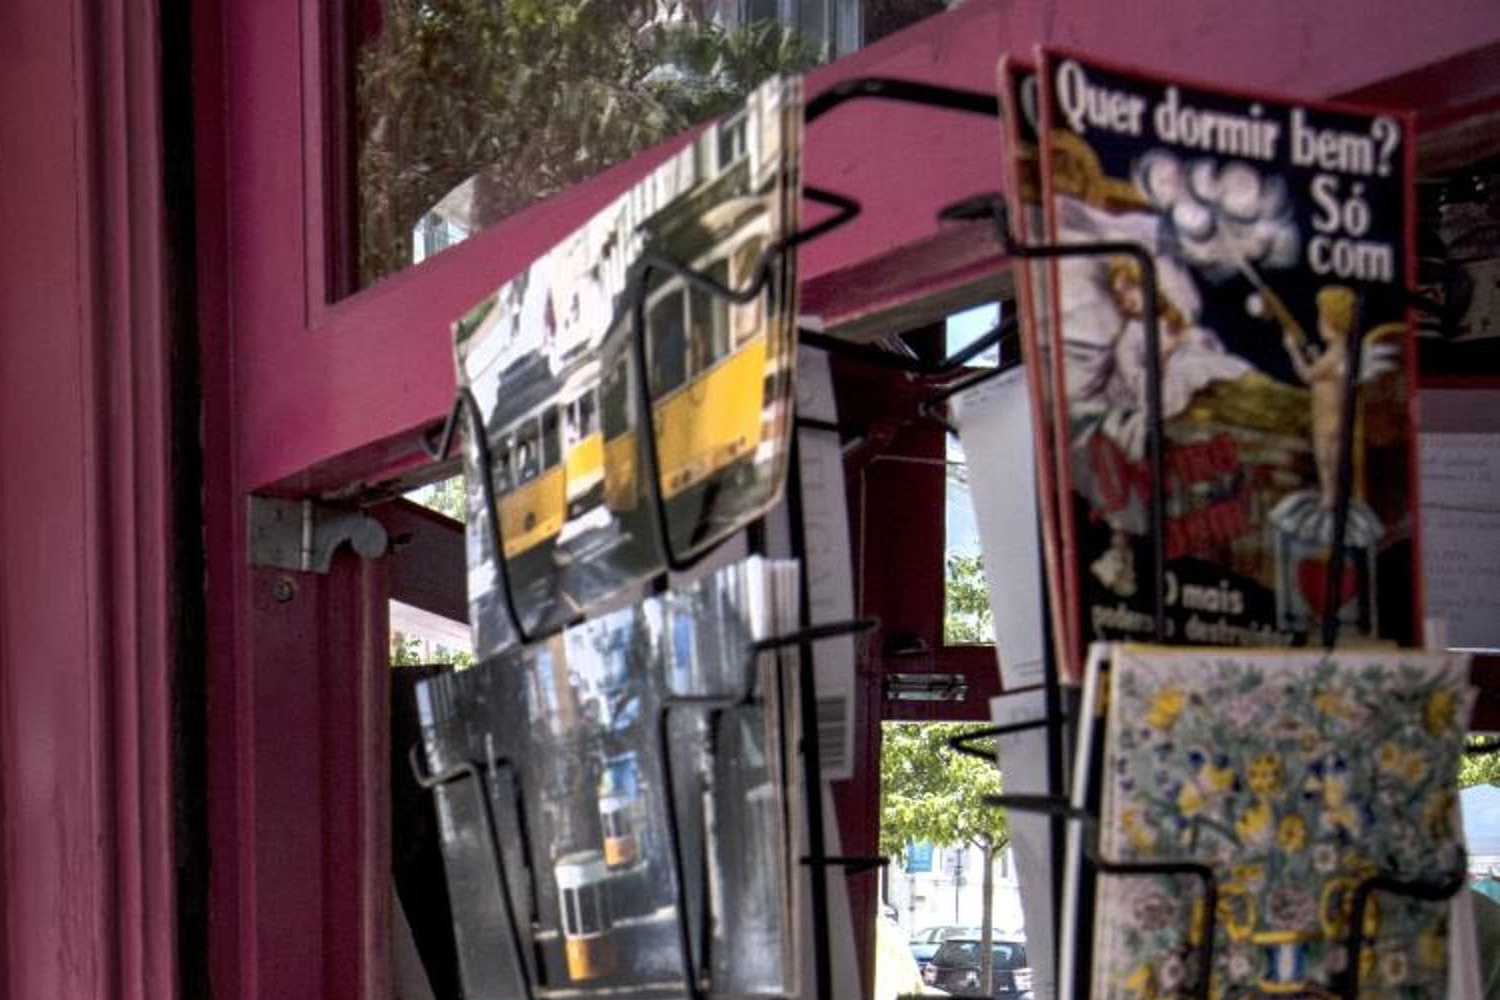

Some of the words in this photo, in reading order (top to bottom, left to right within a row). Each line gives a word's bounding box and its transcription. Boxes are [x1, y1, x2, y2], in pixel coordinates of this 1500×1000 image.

[1056, 60, 1146, 134] Quer
[1154, 86, 1280, 161] dormir
[1290, 107, 1400, 176] bem?
[1310, 175, 1371, 237] Só
[1308, 236, 1394, 283] com
[1181, 579, 1244, 615] mais
